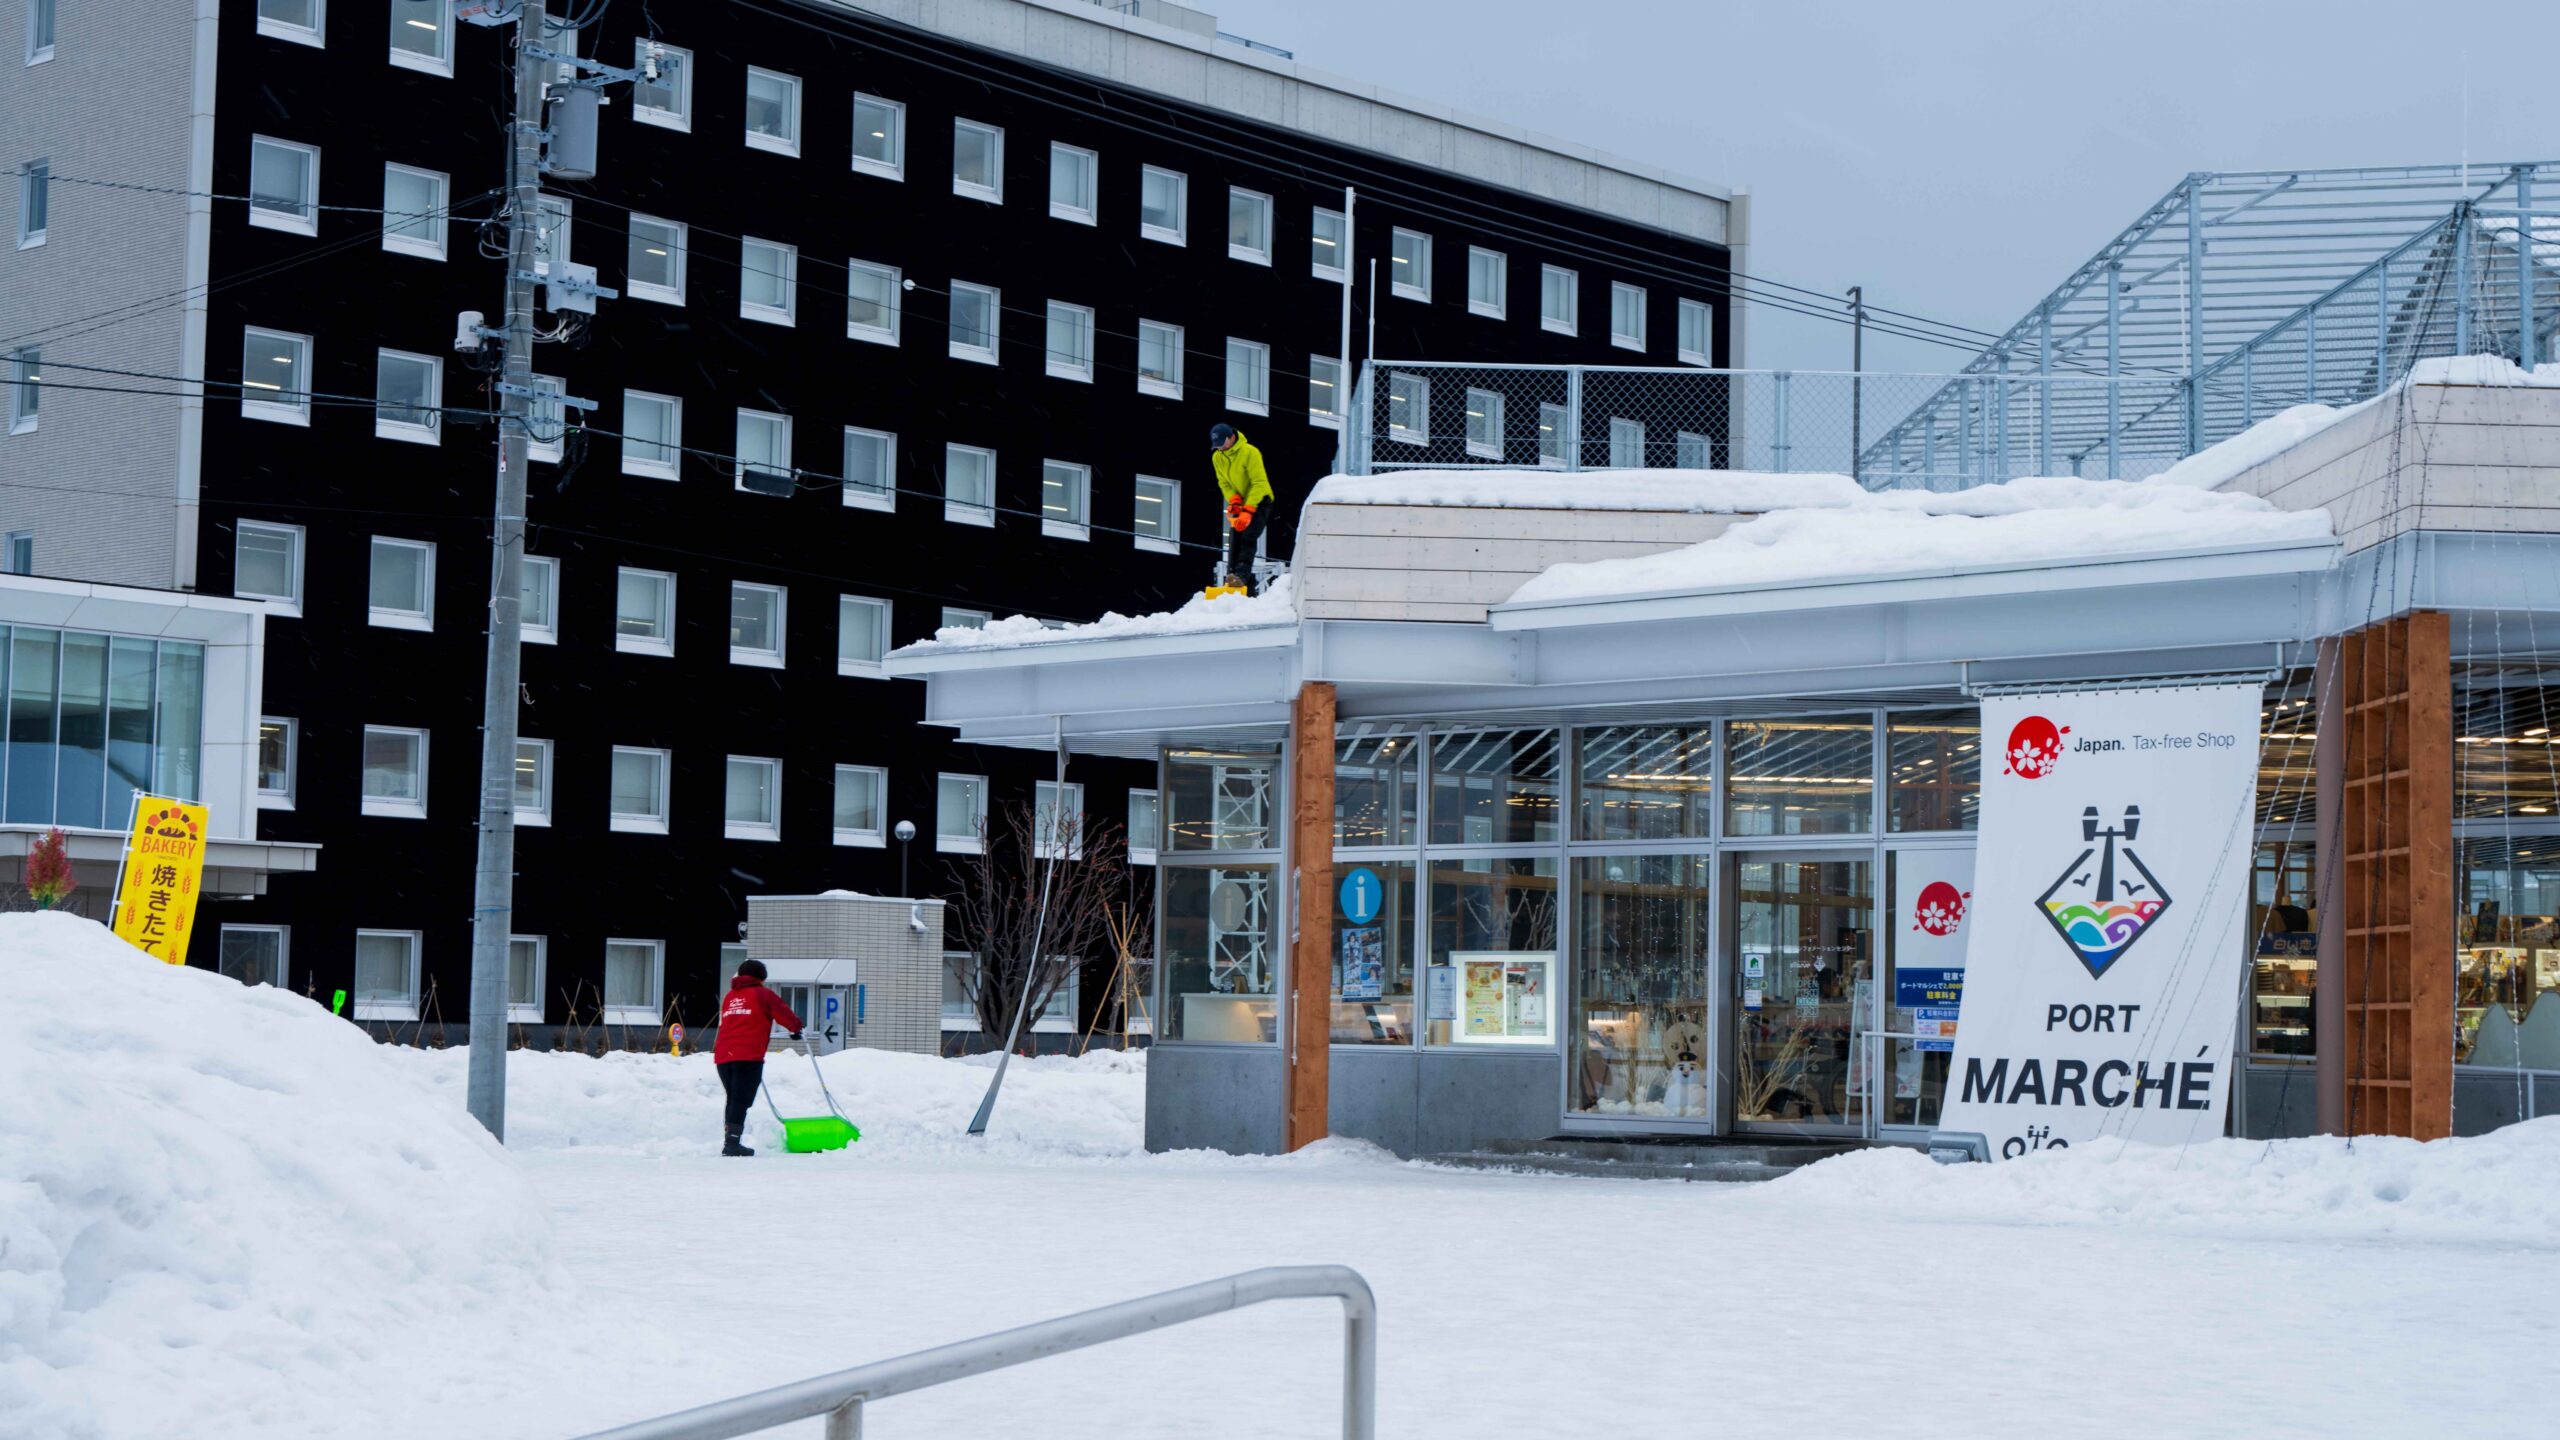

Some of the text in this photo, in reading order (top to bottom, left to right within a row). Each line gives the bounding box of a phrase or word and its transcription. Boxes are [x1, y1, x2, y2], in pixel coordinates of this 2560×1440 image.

[2074, 732, 2236, 755] Japan. Tax-free Shop
[141, 836, 197, 860] BAKERY
[1355, 875, 1368, 917] i
[826, 997, 839, 1020] P
[2046, 1003, 2140, 1033] PORT
[1961, 1046, 2215, 1111] MARCHÉ
